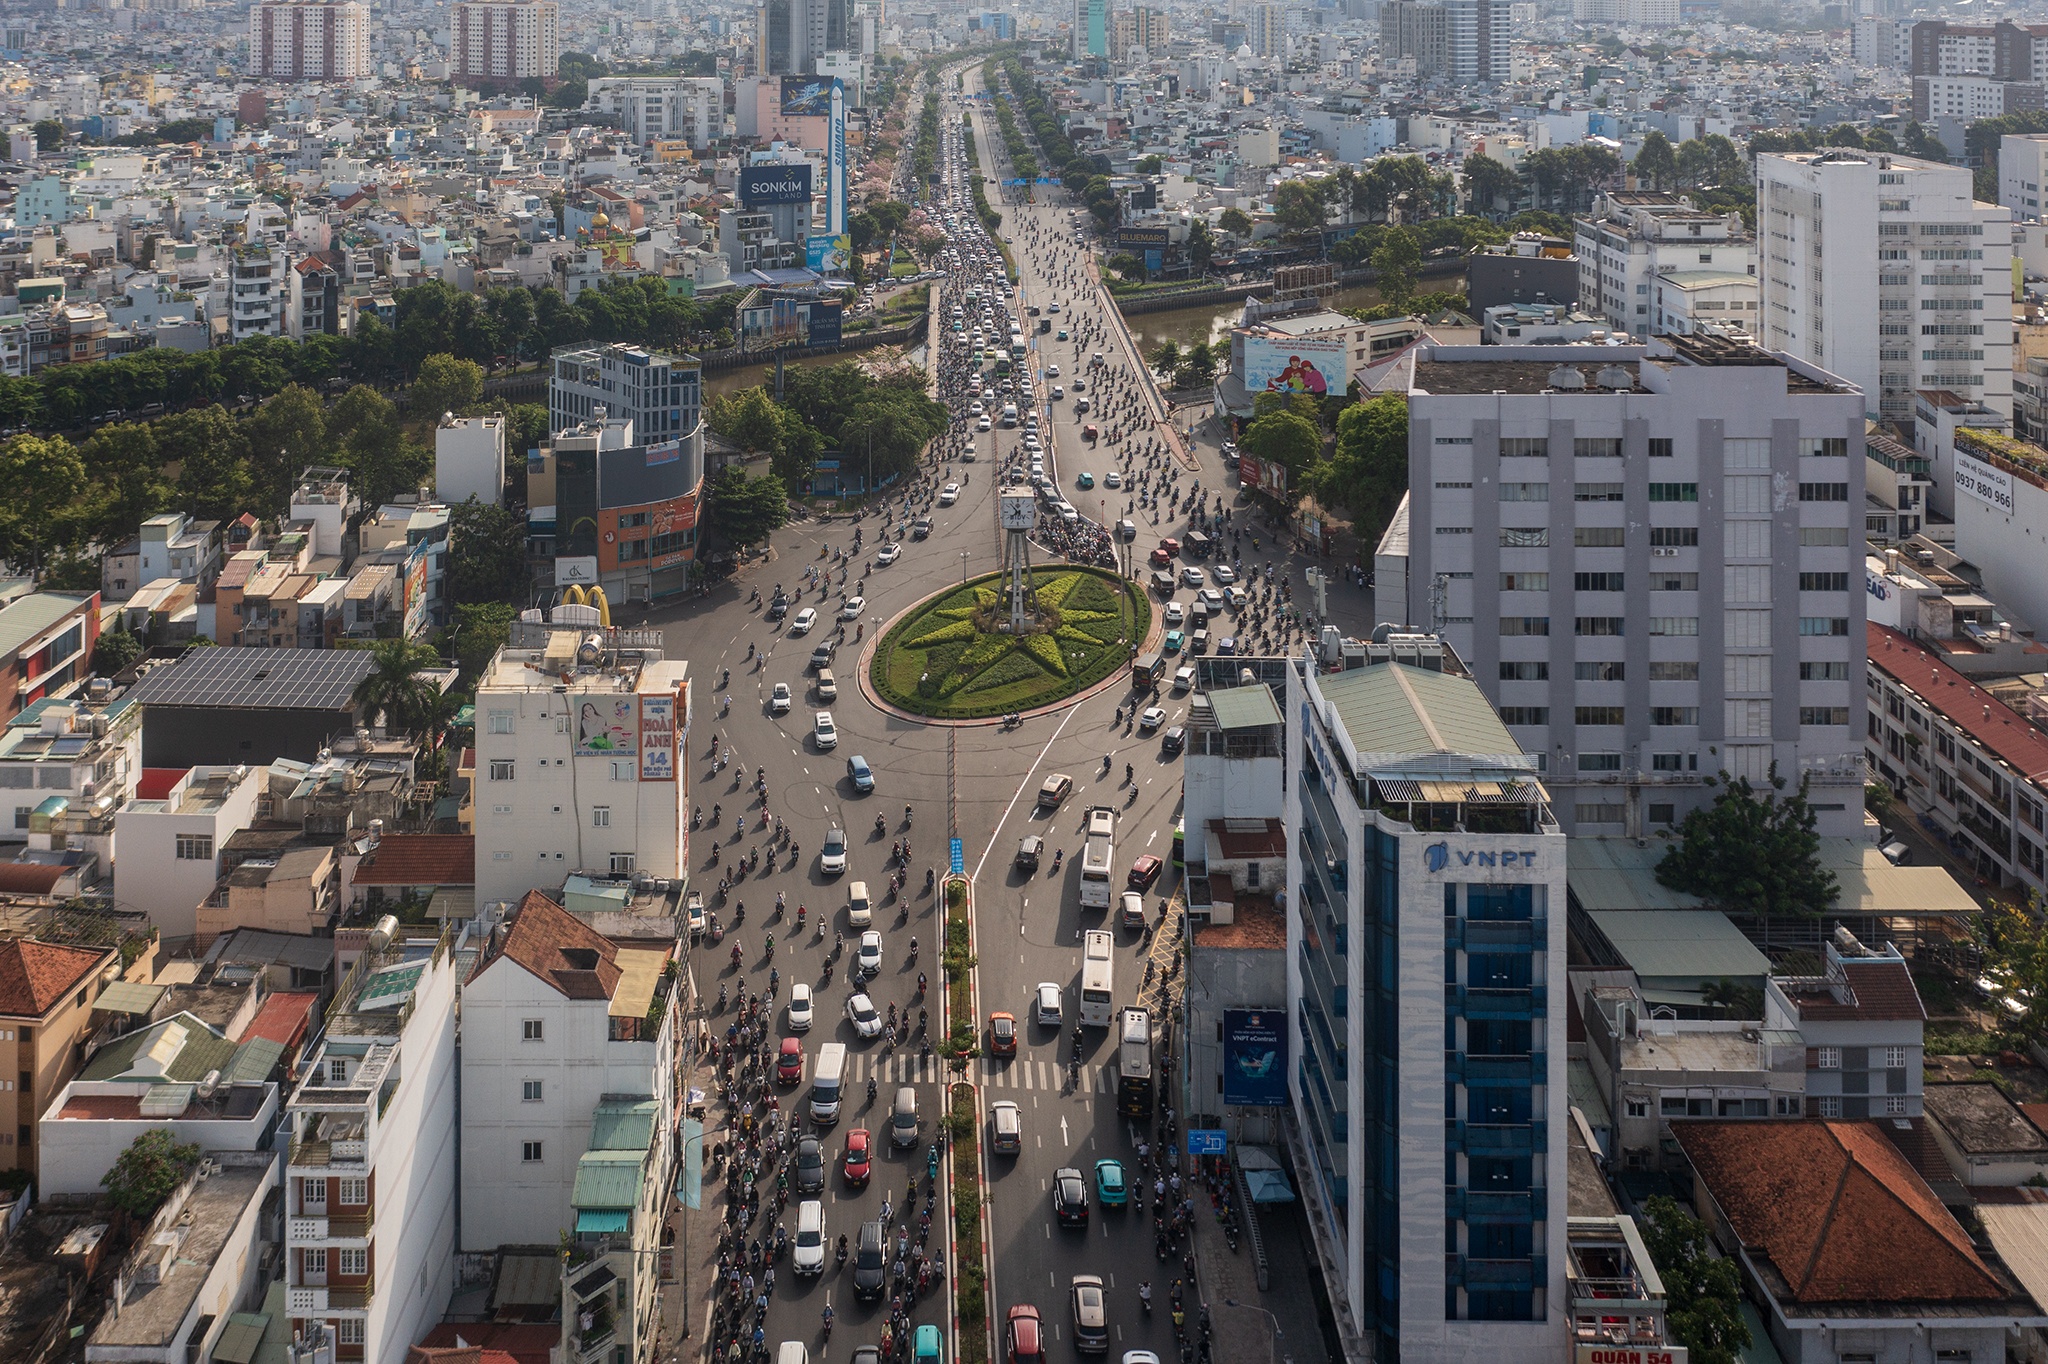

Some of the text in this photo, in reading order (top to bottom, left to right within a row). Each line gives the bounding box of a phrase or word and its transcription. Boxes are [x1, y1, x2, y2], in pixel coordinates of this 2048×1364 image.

[835, 118, 843, 167] SAWACO
[751, 181, 802, 194] SONKIM
[1120, 233, 1167, 242] BLUEMARQ
[1959, 459, 2006, 487] LIÊN HỆ QUẢNG CÁO
[1955, 471, 2011, 507] 0937 880 966
[660, 555, 686, 566] POPEYES
[651, 707, 666, 715] VIỆN
[643, 715, 673, 732] HOÀI
[644, 734, 672, 748] ANH
[647, 751, 667, 766] 14
[1311, 725, 1337, 795] VNPT
[1457, 851, 1537, 867] VNPT
[1647, 1352, 1673, 1364] 54
